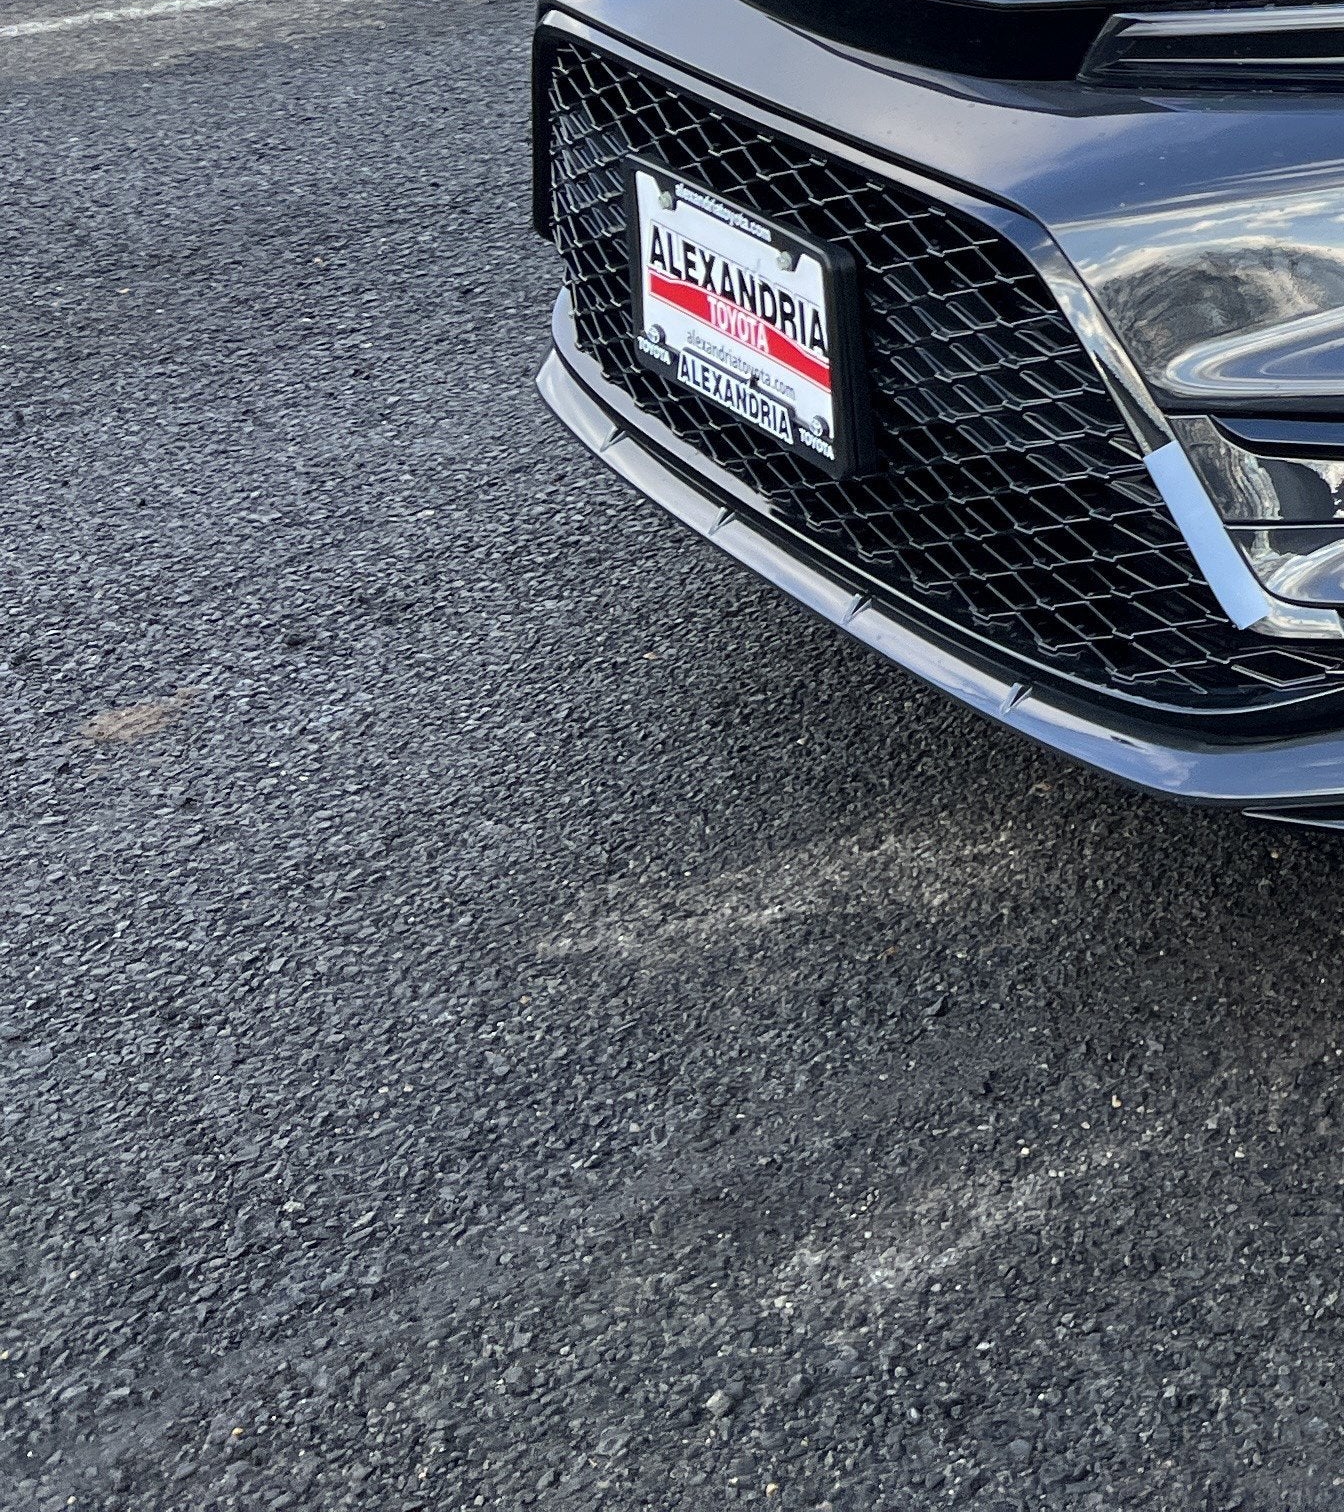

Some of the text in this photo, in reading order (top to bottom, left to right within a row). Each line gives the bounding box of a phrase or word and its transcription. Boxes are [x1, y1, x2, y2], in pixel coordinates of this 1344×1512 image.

[650, 224, 829, 356] ALEXANDRIA
[637, 336, 672, 365] TOYOTA
[706, 295, 770, 355] TOYOTA
[680, 354, 793, 439] ALEXANDRIA
[686, 329, 796, 401] alexandriatoyota.com
[799, 427, 836, 461] TOYOTA
